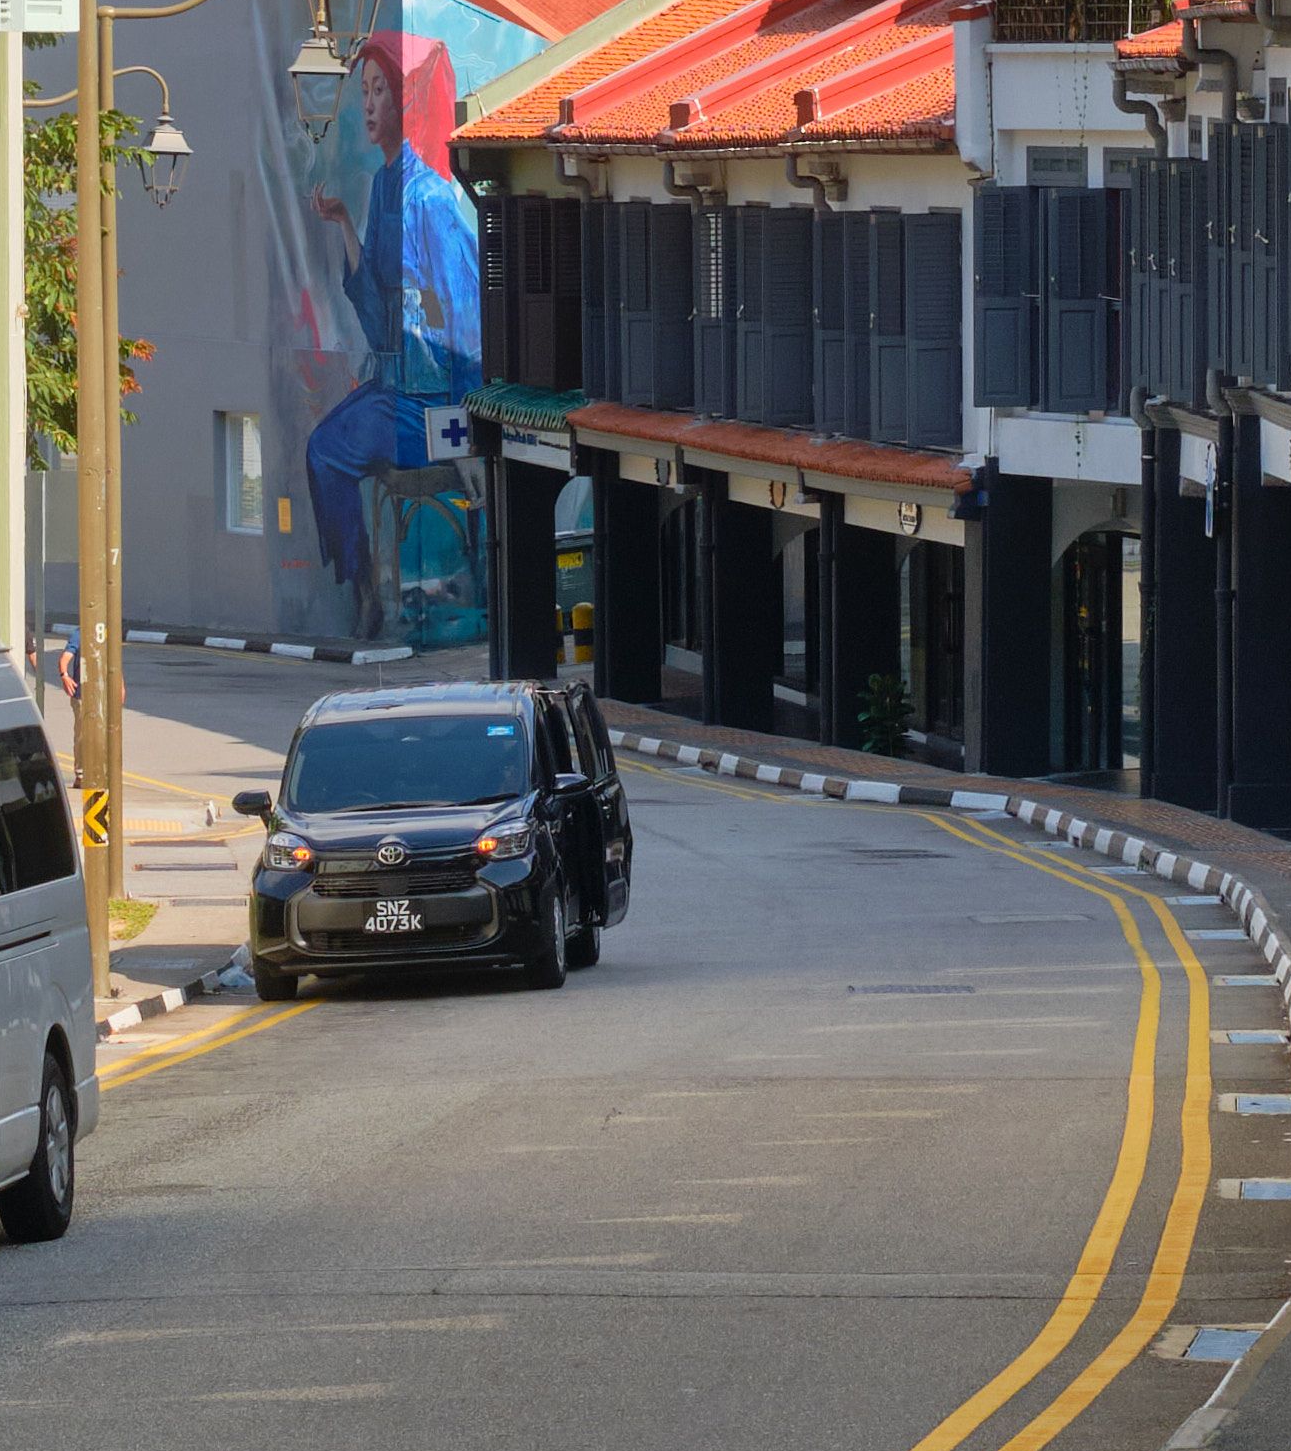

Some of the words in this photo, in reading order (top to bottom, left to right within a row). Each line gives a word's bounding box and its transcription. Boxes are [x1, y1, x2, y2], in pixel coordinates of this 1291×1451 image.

[111, 548, 119, 566] 7
[95, 623, 105, 643] 8
[376, 900, 410, 915] SNZ
[365, 914, 421, 932] 4073K
